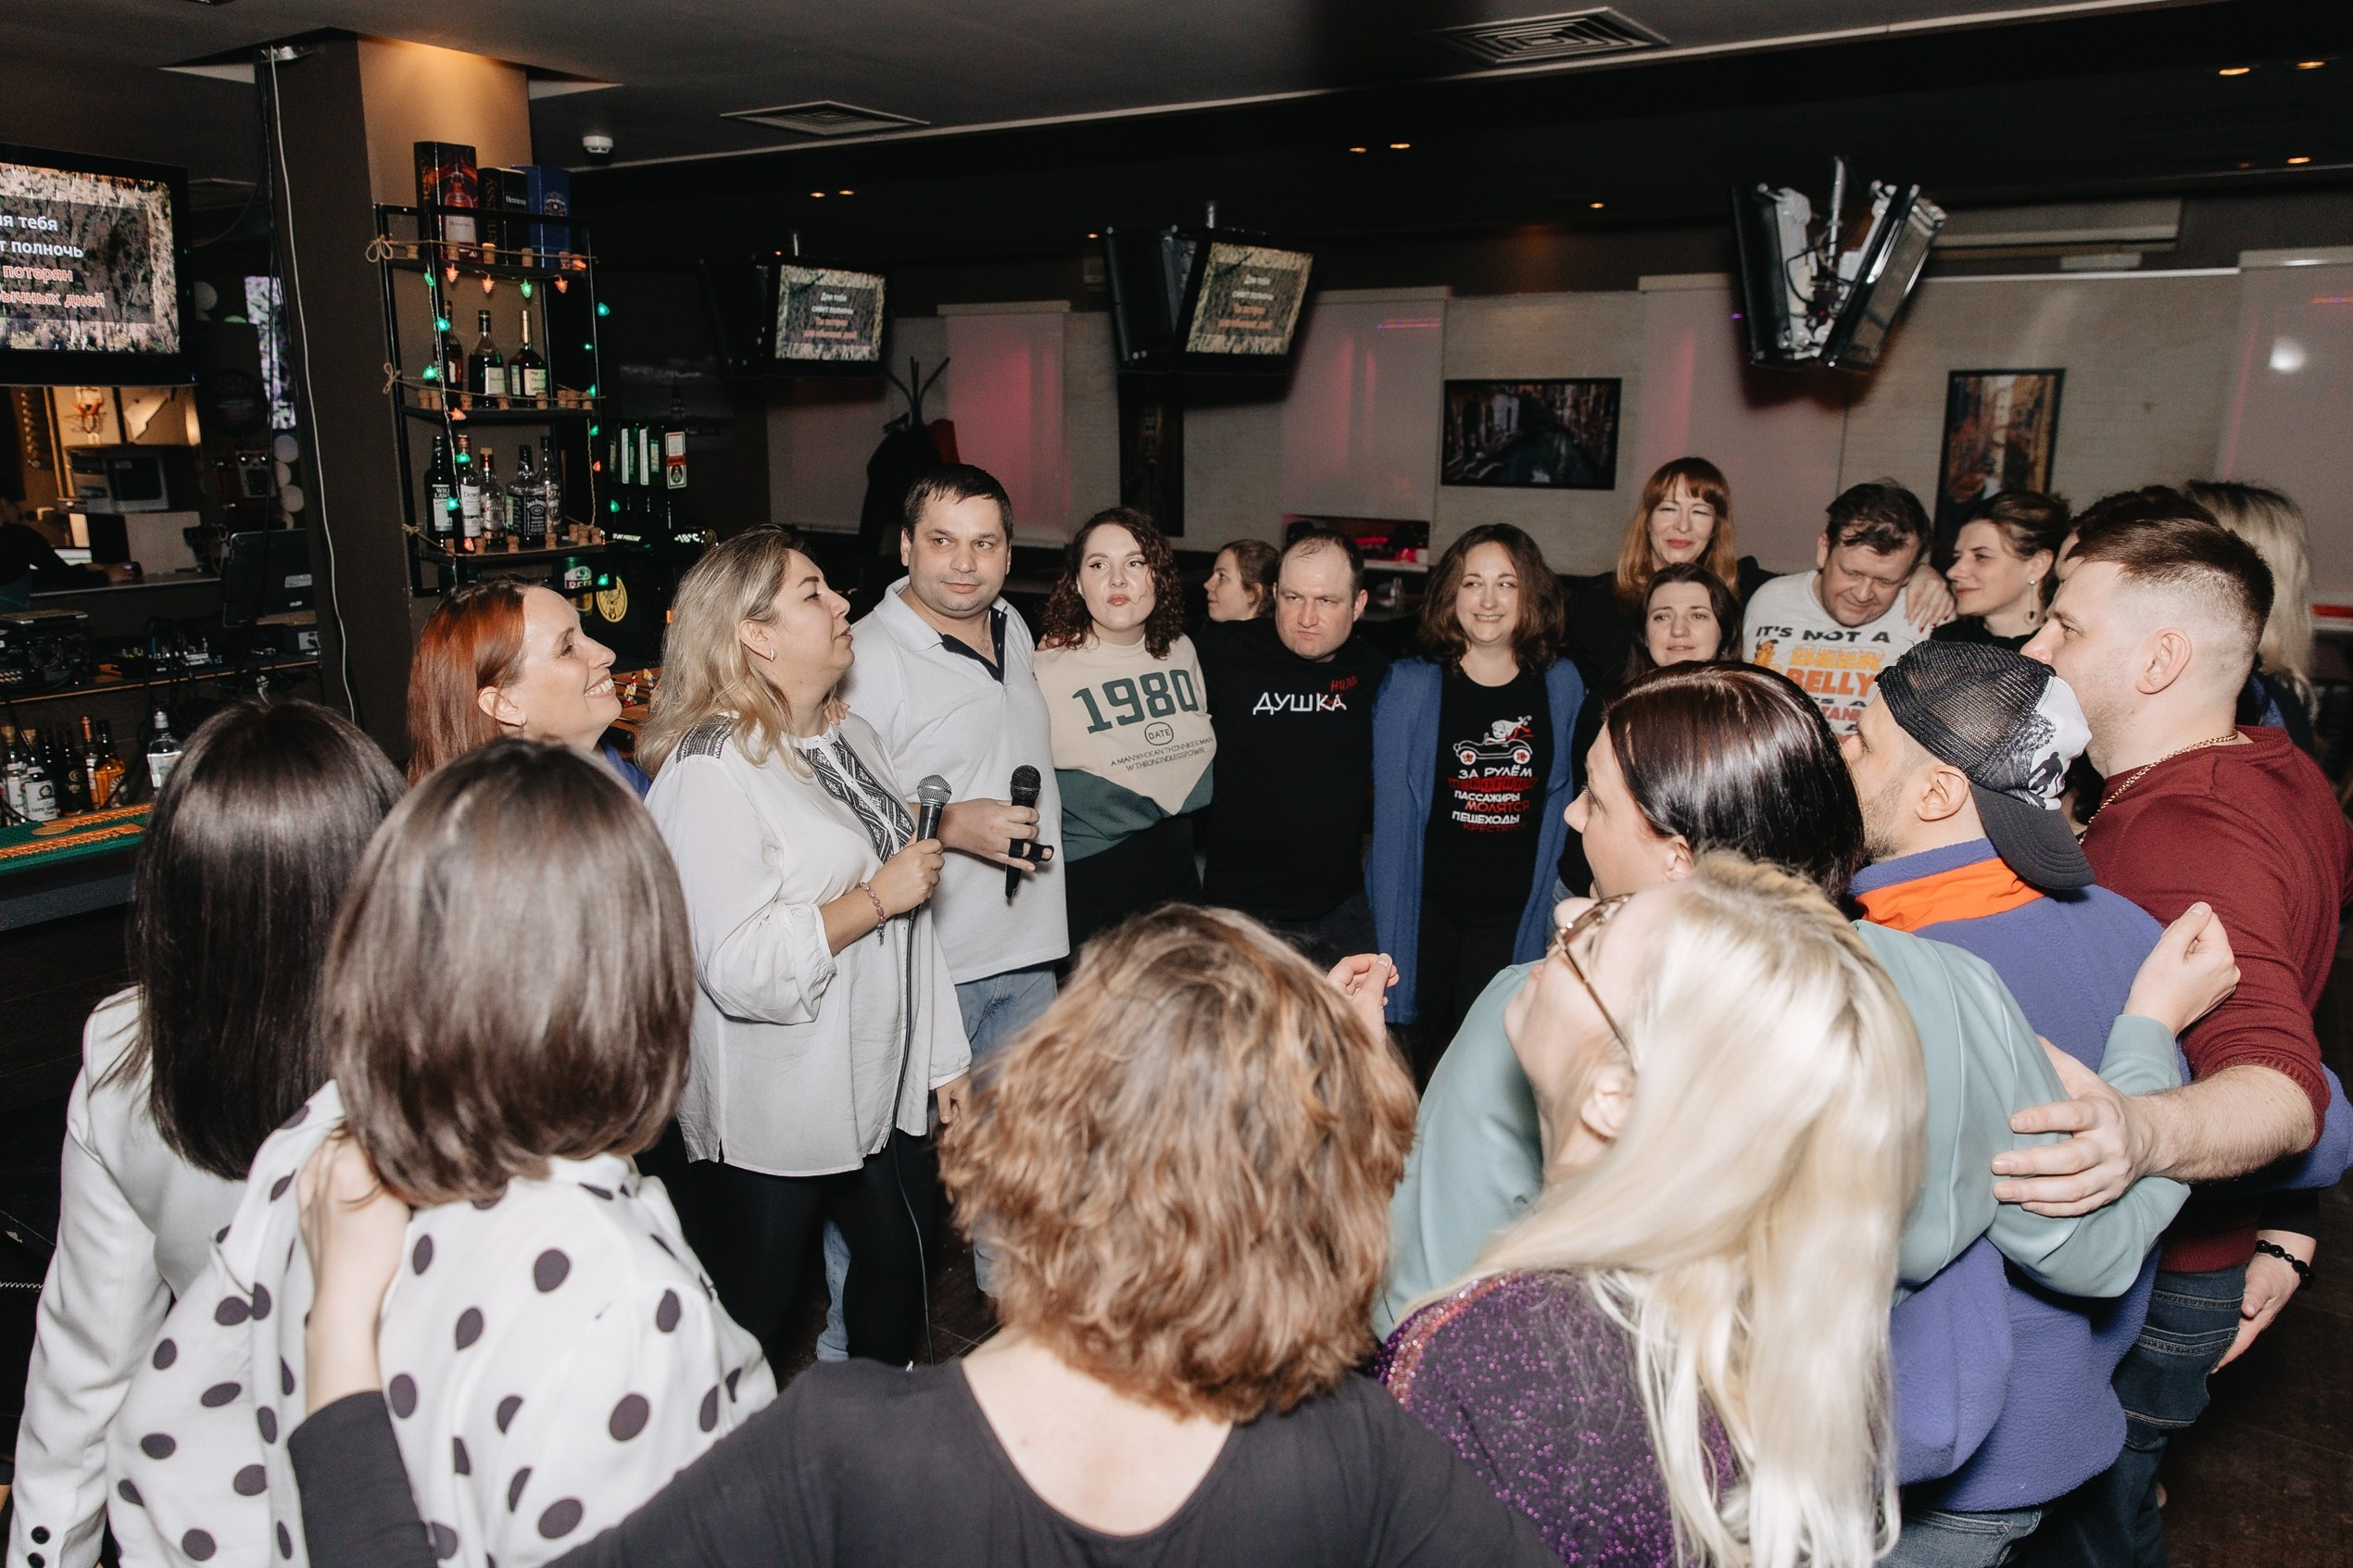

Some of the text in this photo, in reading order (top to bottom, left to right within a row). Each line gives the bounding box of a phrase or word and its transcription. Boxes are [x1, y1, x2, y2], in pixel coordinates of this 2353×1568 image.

[18, 216, 58, 232] тебя
[11, 241, 84, 258] полночь
[3, 265, 73, 283] потерян
[0, 291, 106, 308] ычных дней
[1755, 625, 1891, 644] IT'S NOT A
[1790, 645, 1885, 671] BEER
[1785, 668, 1876, 697] BELLY
[1072, 669, 1200, 734] 1980
[1252, 692, 1347, 716] ДУШКА
[1148, 728, 1172, 740] DATE
[1458, 764, 1533, 780] ЗА РУЛЁМ
[1453, 790, 1521, 803] ПАССАЖИРЫ
[1465, 800, 1530, 814] МОЛЯТСЯ
[1452, 810, 1520, 824] ПЕШЕХОДЫ
